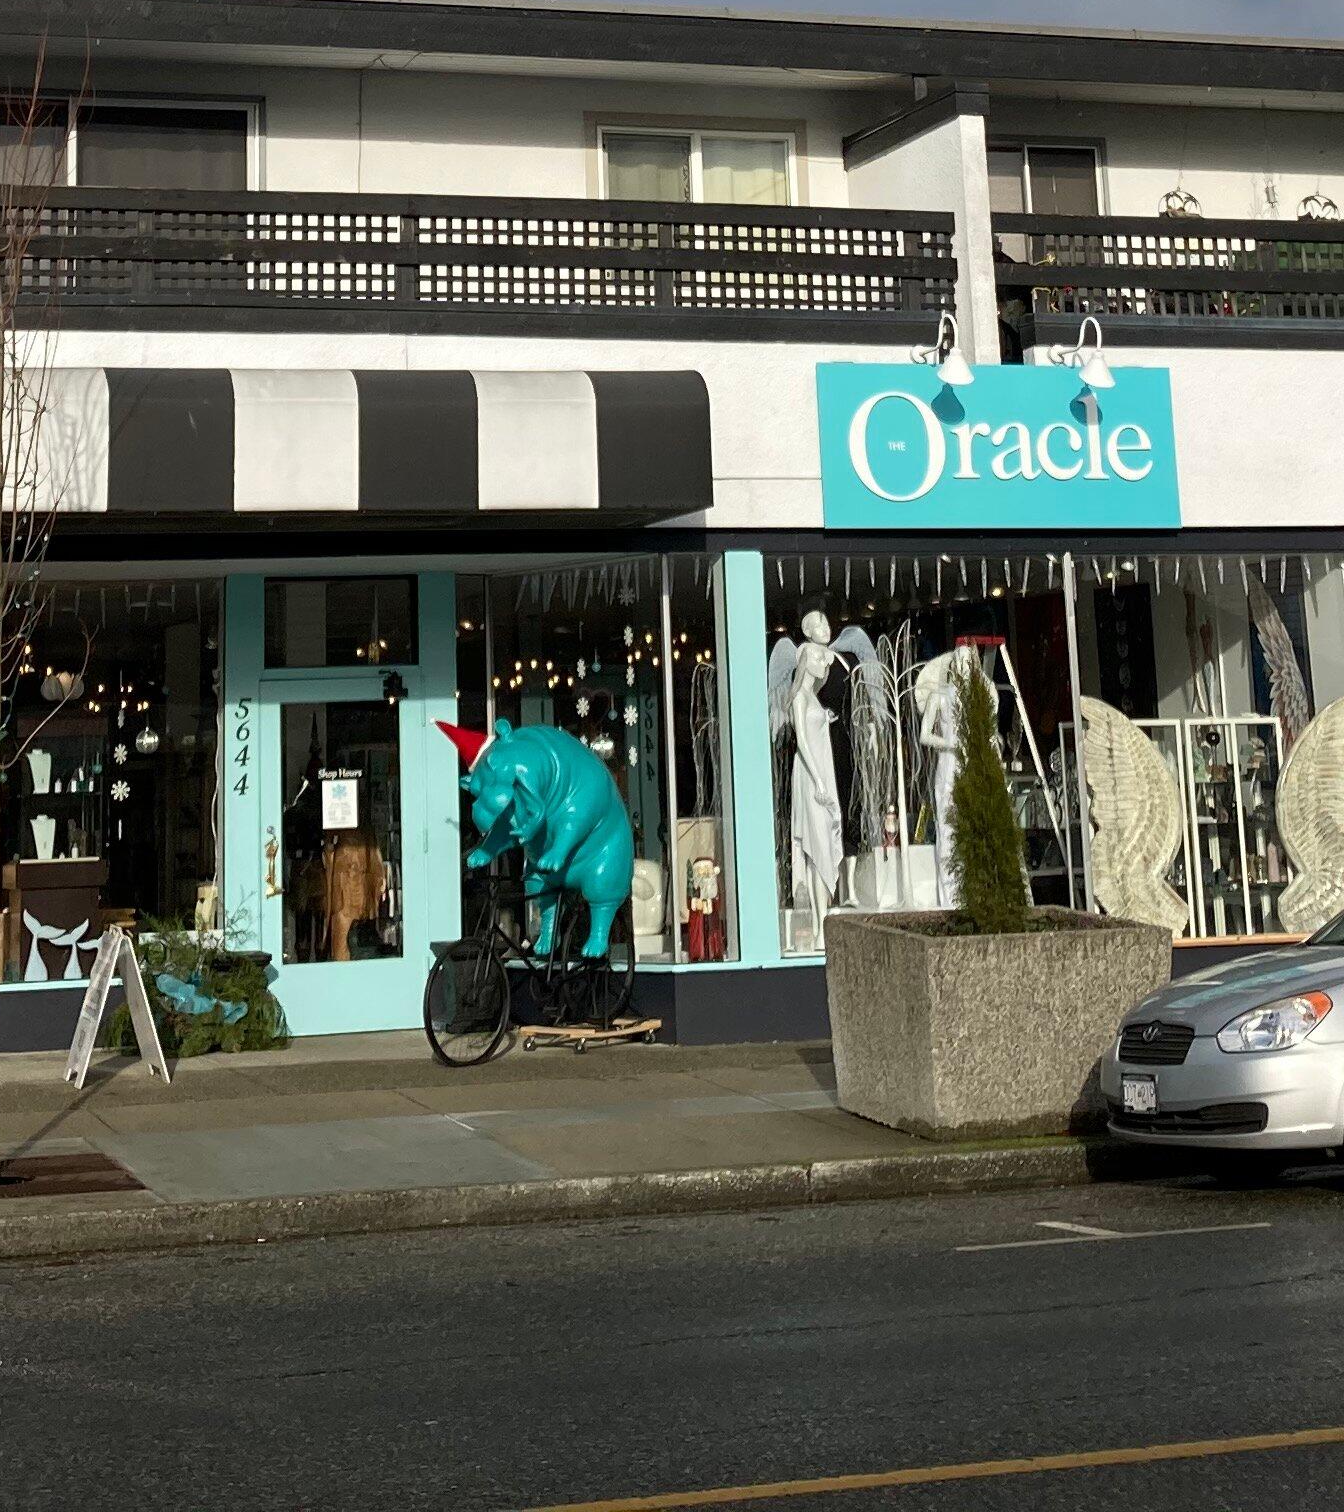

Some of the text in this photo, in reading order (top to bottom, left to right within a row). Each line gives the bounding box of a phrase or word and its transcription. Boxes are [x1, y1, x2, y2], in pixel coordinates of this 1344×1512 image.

[849, 391, 1153, 502] THE Oracle
[233, 697, 252, 796] 5644
[318, 767, 363, 780] Shop Hours
